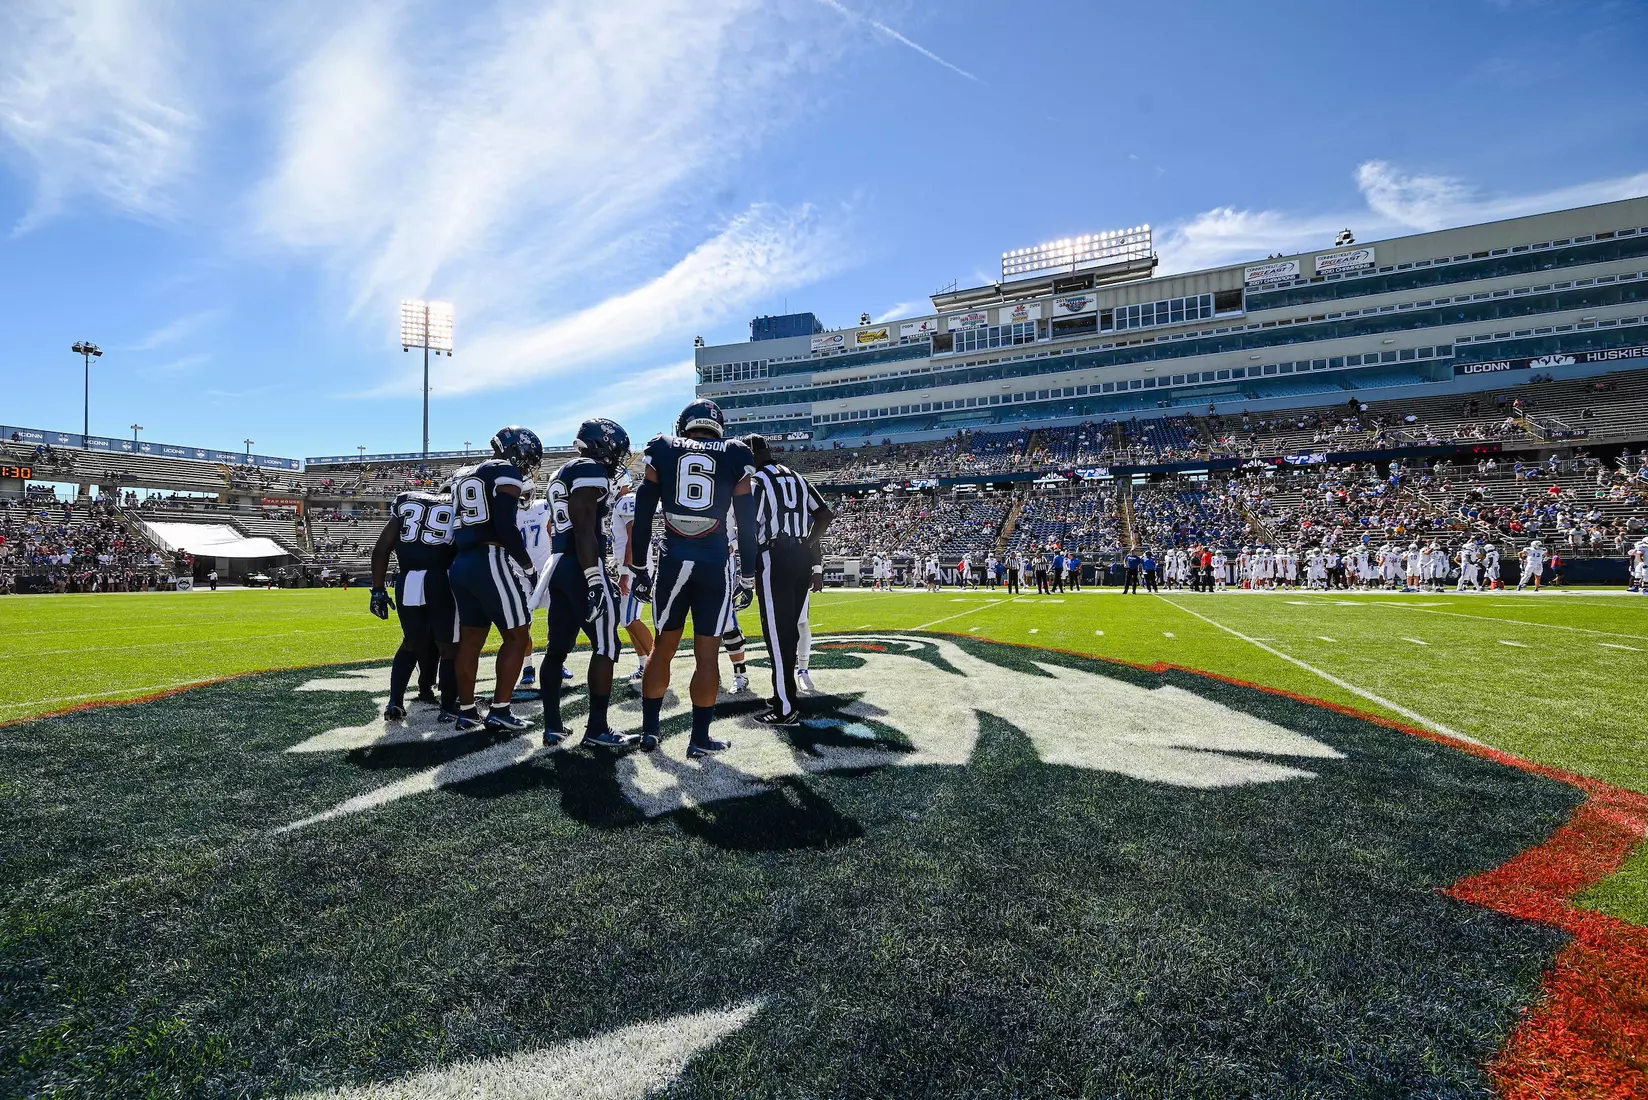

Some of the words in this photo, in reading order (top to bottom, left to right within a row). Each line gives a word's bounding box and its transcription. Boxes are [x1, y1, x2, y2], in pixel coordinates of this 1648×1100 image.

[1336, 254, 1361, 263] EAST
[1263, 267, 1286, 275] EAST
[1335, 263, 1371, 272] CHAMPIONS
[1264, 275, 1296, 284] CHAMPIONS
[1587, 348, 1648, 362] HUSKIES
[1464, 361, 1510, 374] UCONN
[710, 408, 718, 419] 6
[695, 419, 720, 430] HUSKIES
[672, 437, 727, 452] SWENSON
[675, 453, 716, 511] 6
[776, 476, 797, 509] U
[452, 476, 490, 529] 9
[547, 479, 574, 536] 6
[398, 501, 455, 545] 39
[520, 524, 541, 548] 17
